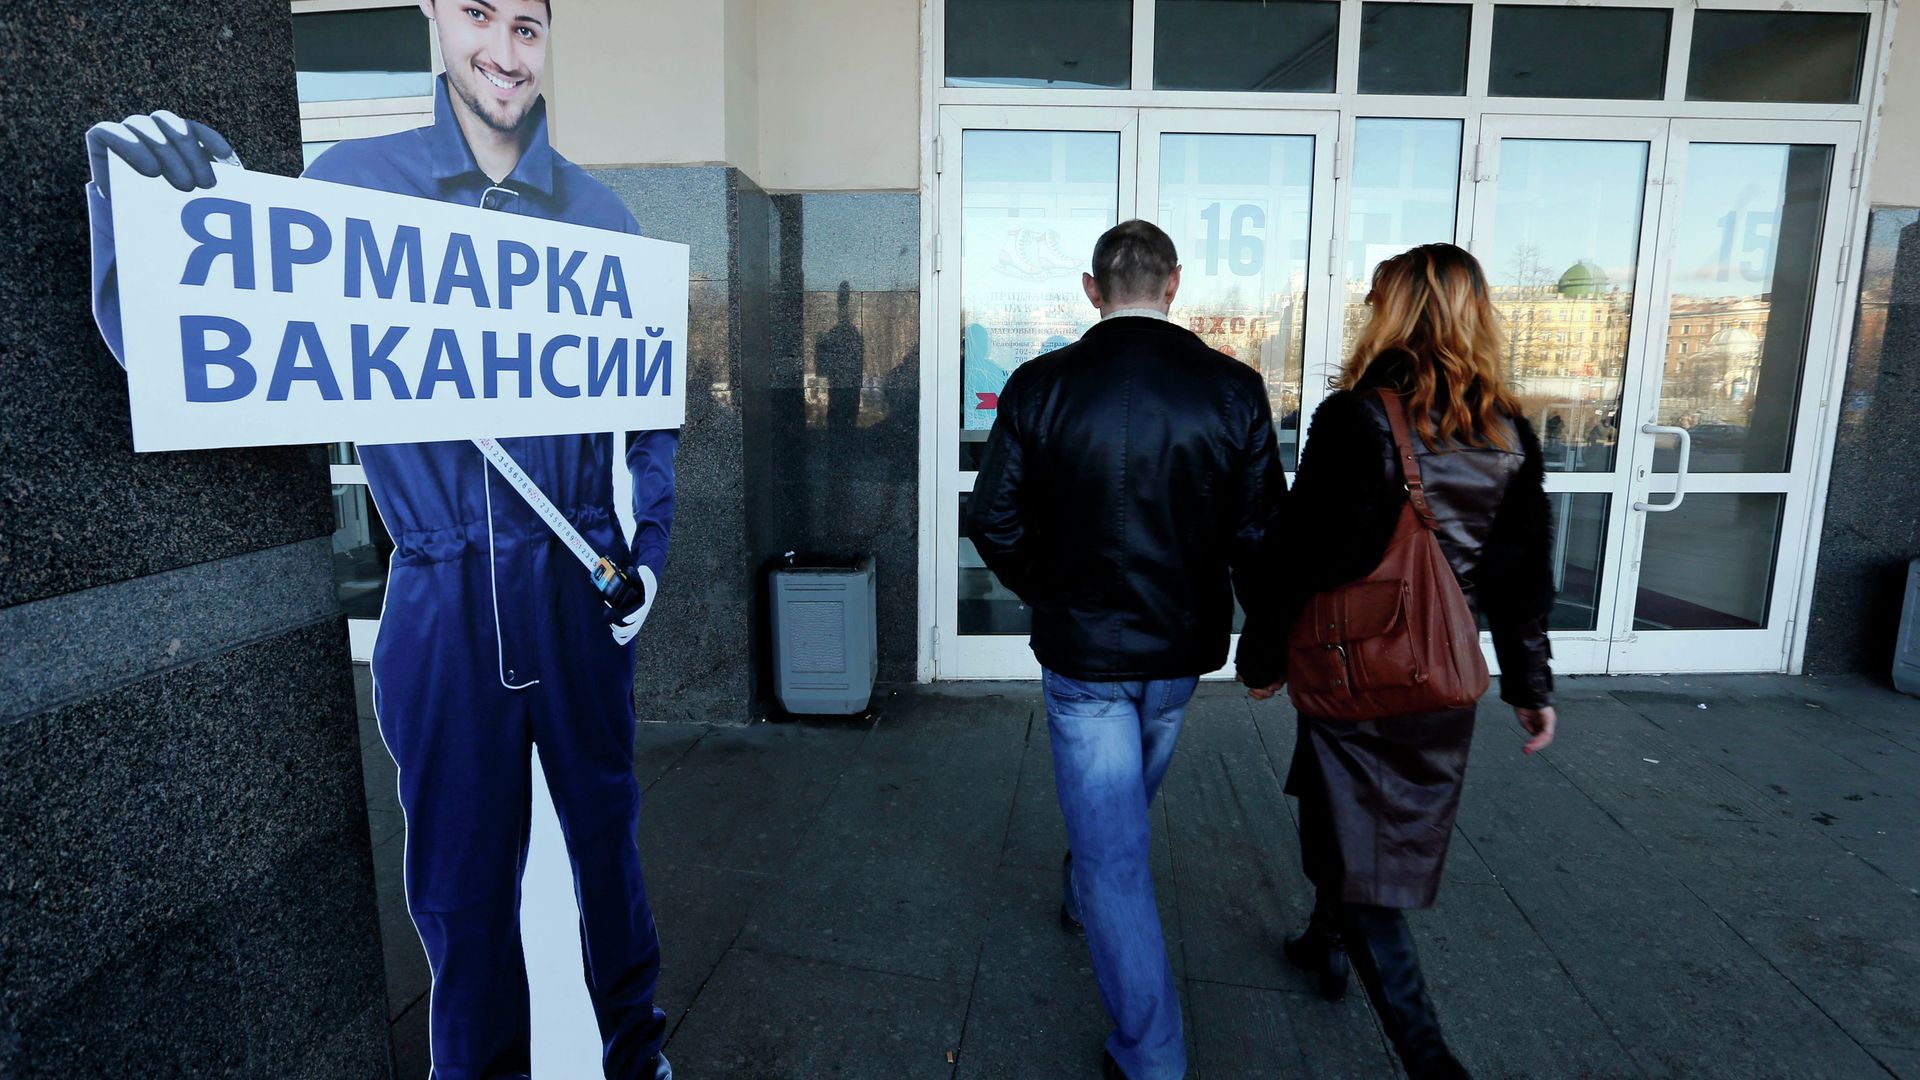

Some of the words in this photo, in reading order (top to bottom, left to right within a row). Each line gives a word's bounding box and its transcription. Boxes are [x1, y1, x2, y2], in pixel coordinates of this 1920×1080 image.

[180, 197, 632, 318] ЯРМАРКА
[1200, 202, 1265, 276] 16
[1716, 210, 1781, 282] 15
[179, 315, 673, 403] ВАКАНСИЙ
